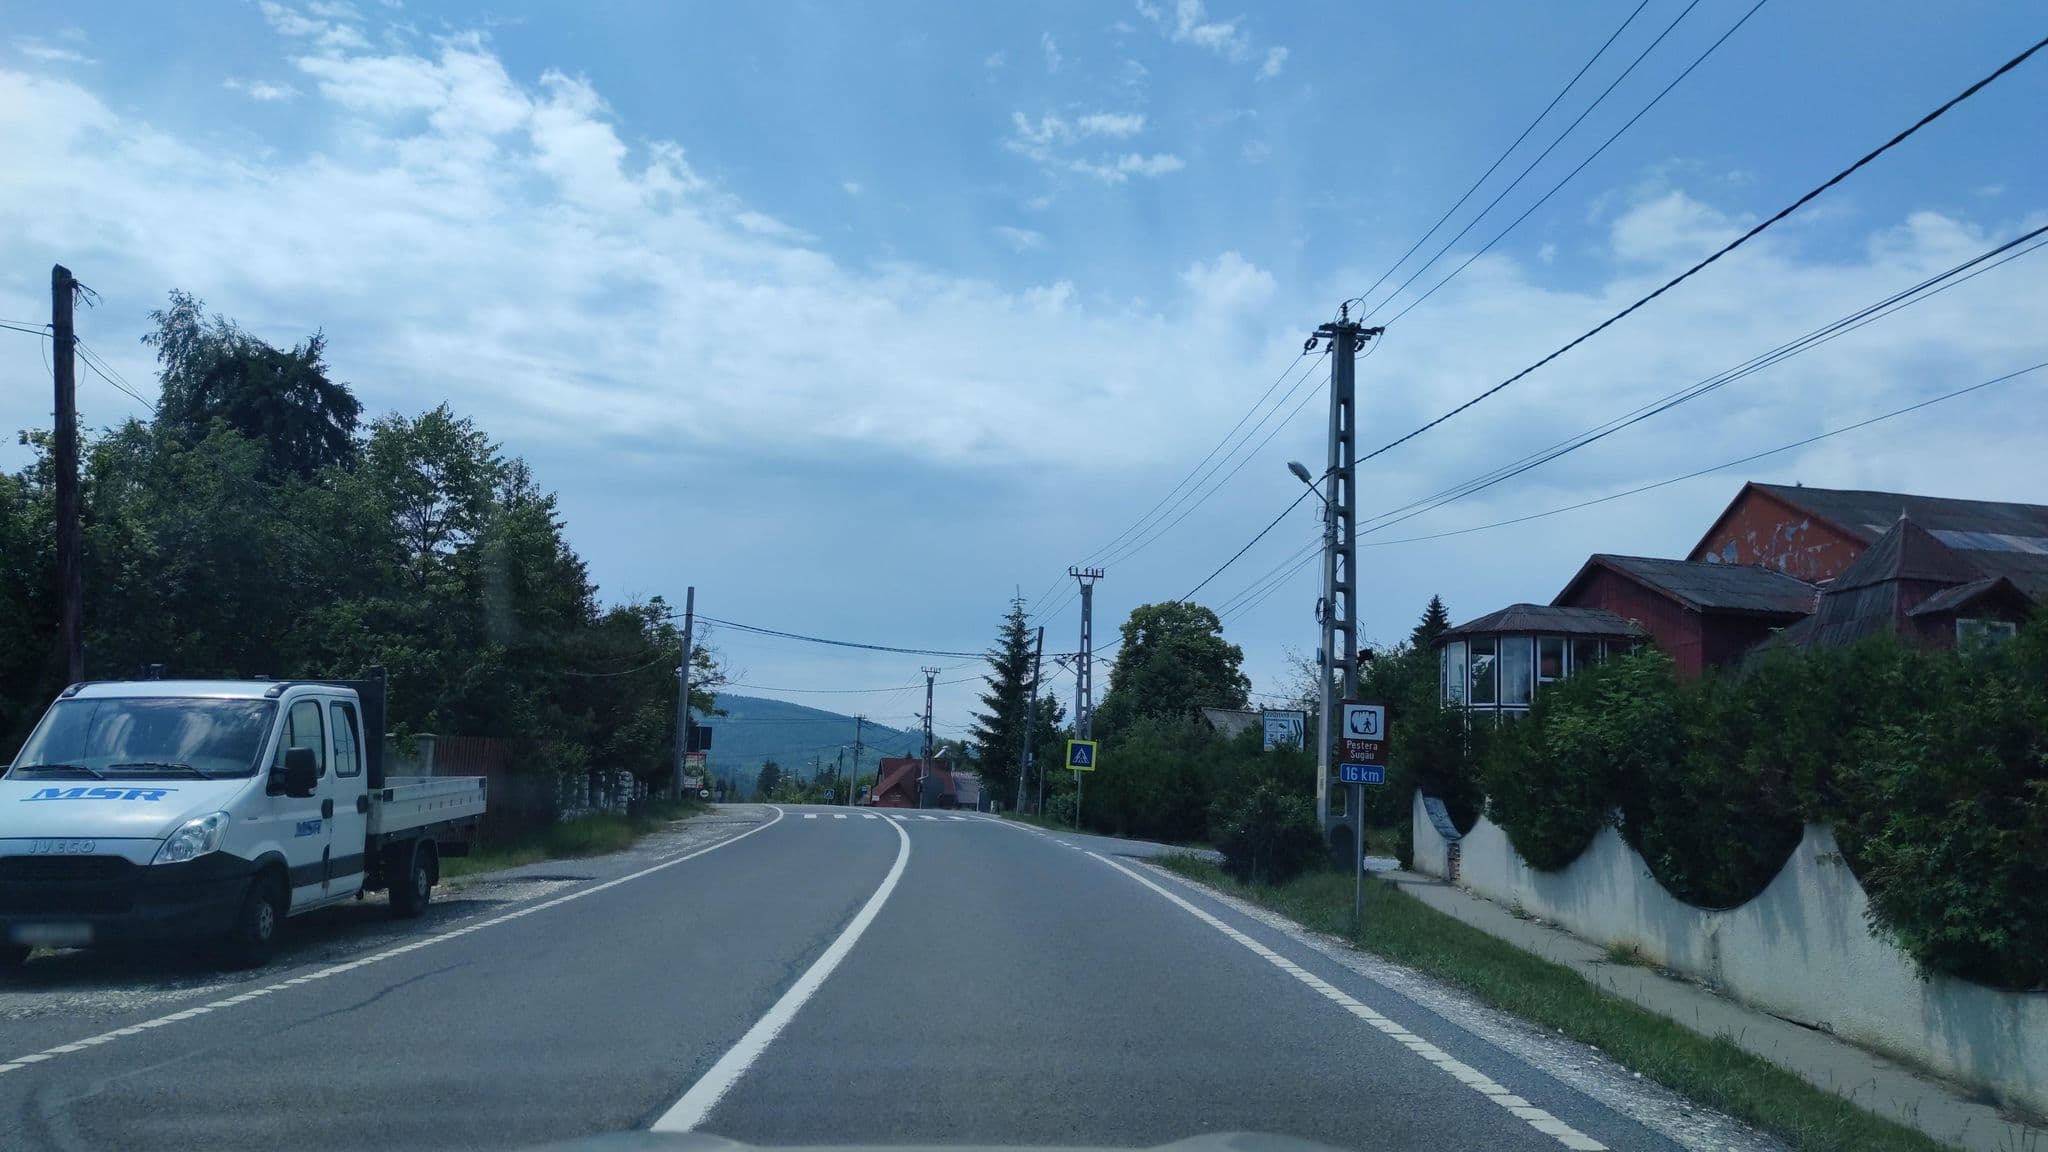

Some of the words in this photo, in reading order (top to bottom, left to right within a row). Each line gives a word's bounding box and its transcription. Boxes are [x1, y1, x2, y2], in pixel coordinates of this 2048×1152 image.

[1346, 766, 1359, 781] 16
[1361, 767, 1380, 782] km
[30, 787, 170, 802] MSR
[29, 839, 96, 854] IVECO
